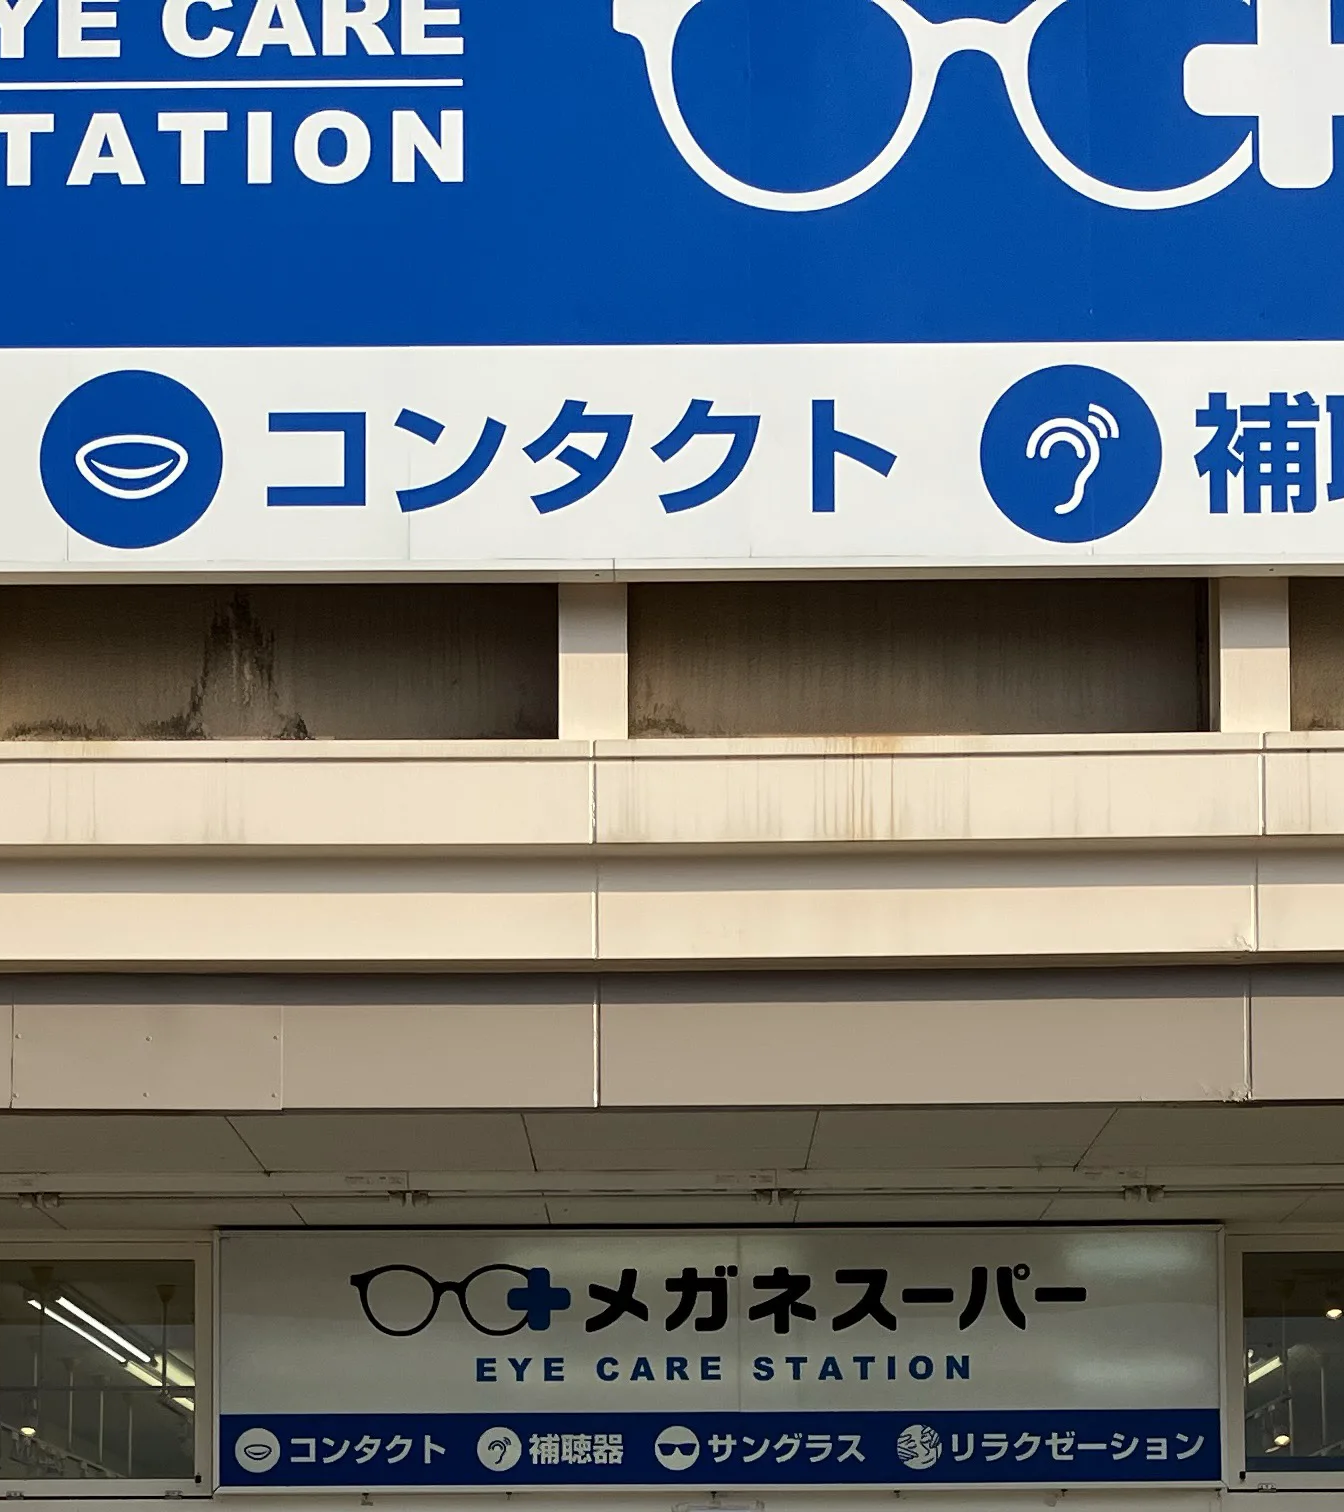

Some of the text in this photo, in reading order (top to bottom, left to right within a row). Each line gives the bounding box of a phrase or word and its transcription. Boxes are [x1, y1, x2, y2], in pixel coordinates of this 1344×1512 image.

[161, 0, 464, 58] CARE
[266, 398, 897, 514] コンタクト
[585, 1264, 1087, 1333] メガネスーパー
[476, 1355, 973, 1382] EYE CARE STATION
[289, 1434, 447, 1465] コンタクト
[528, 1432, 625, 1465] 補聴器
[707, 1432, 866, 1464] サングラス
[949, 1431, 1205, 1464] リラクゼーション
